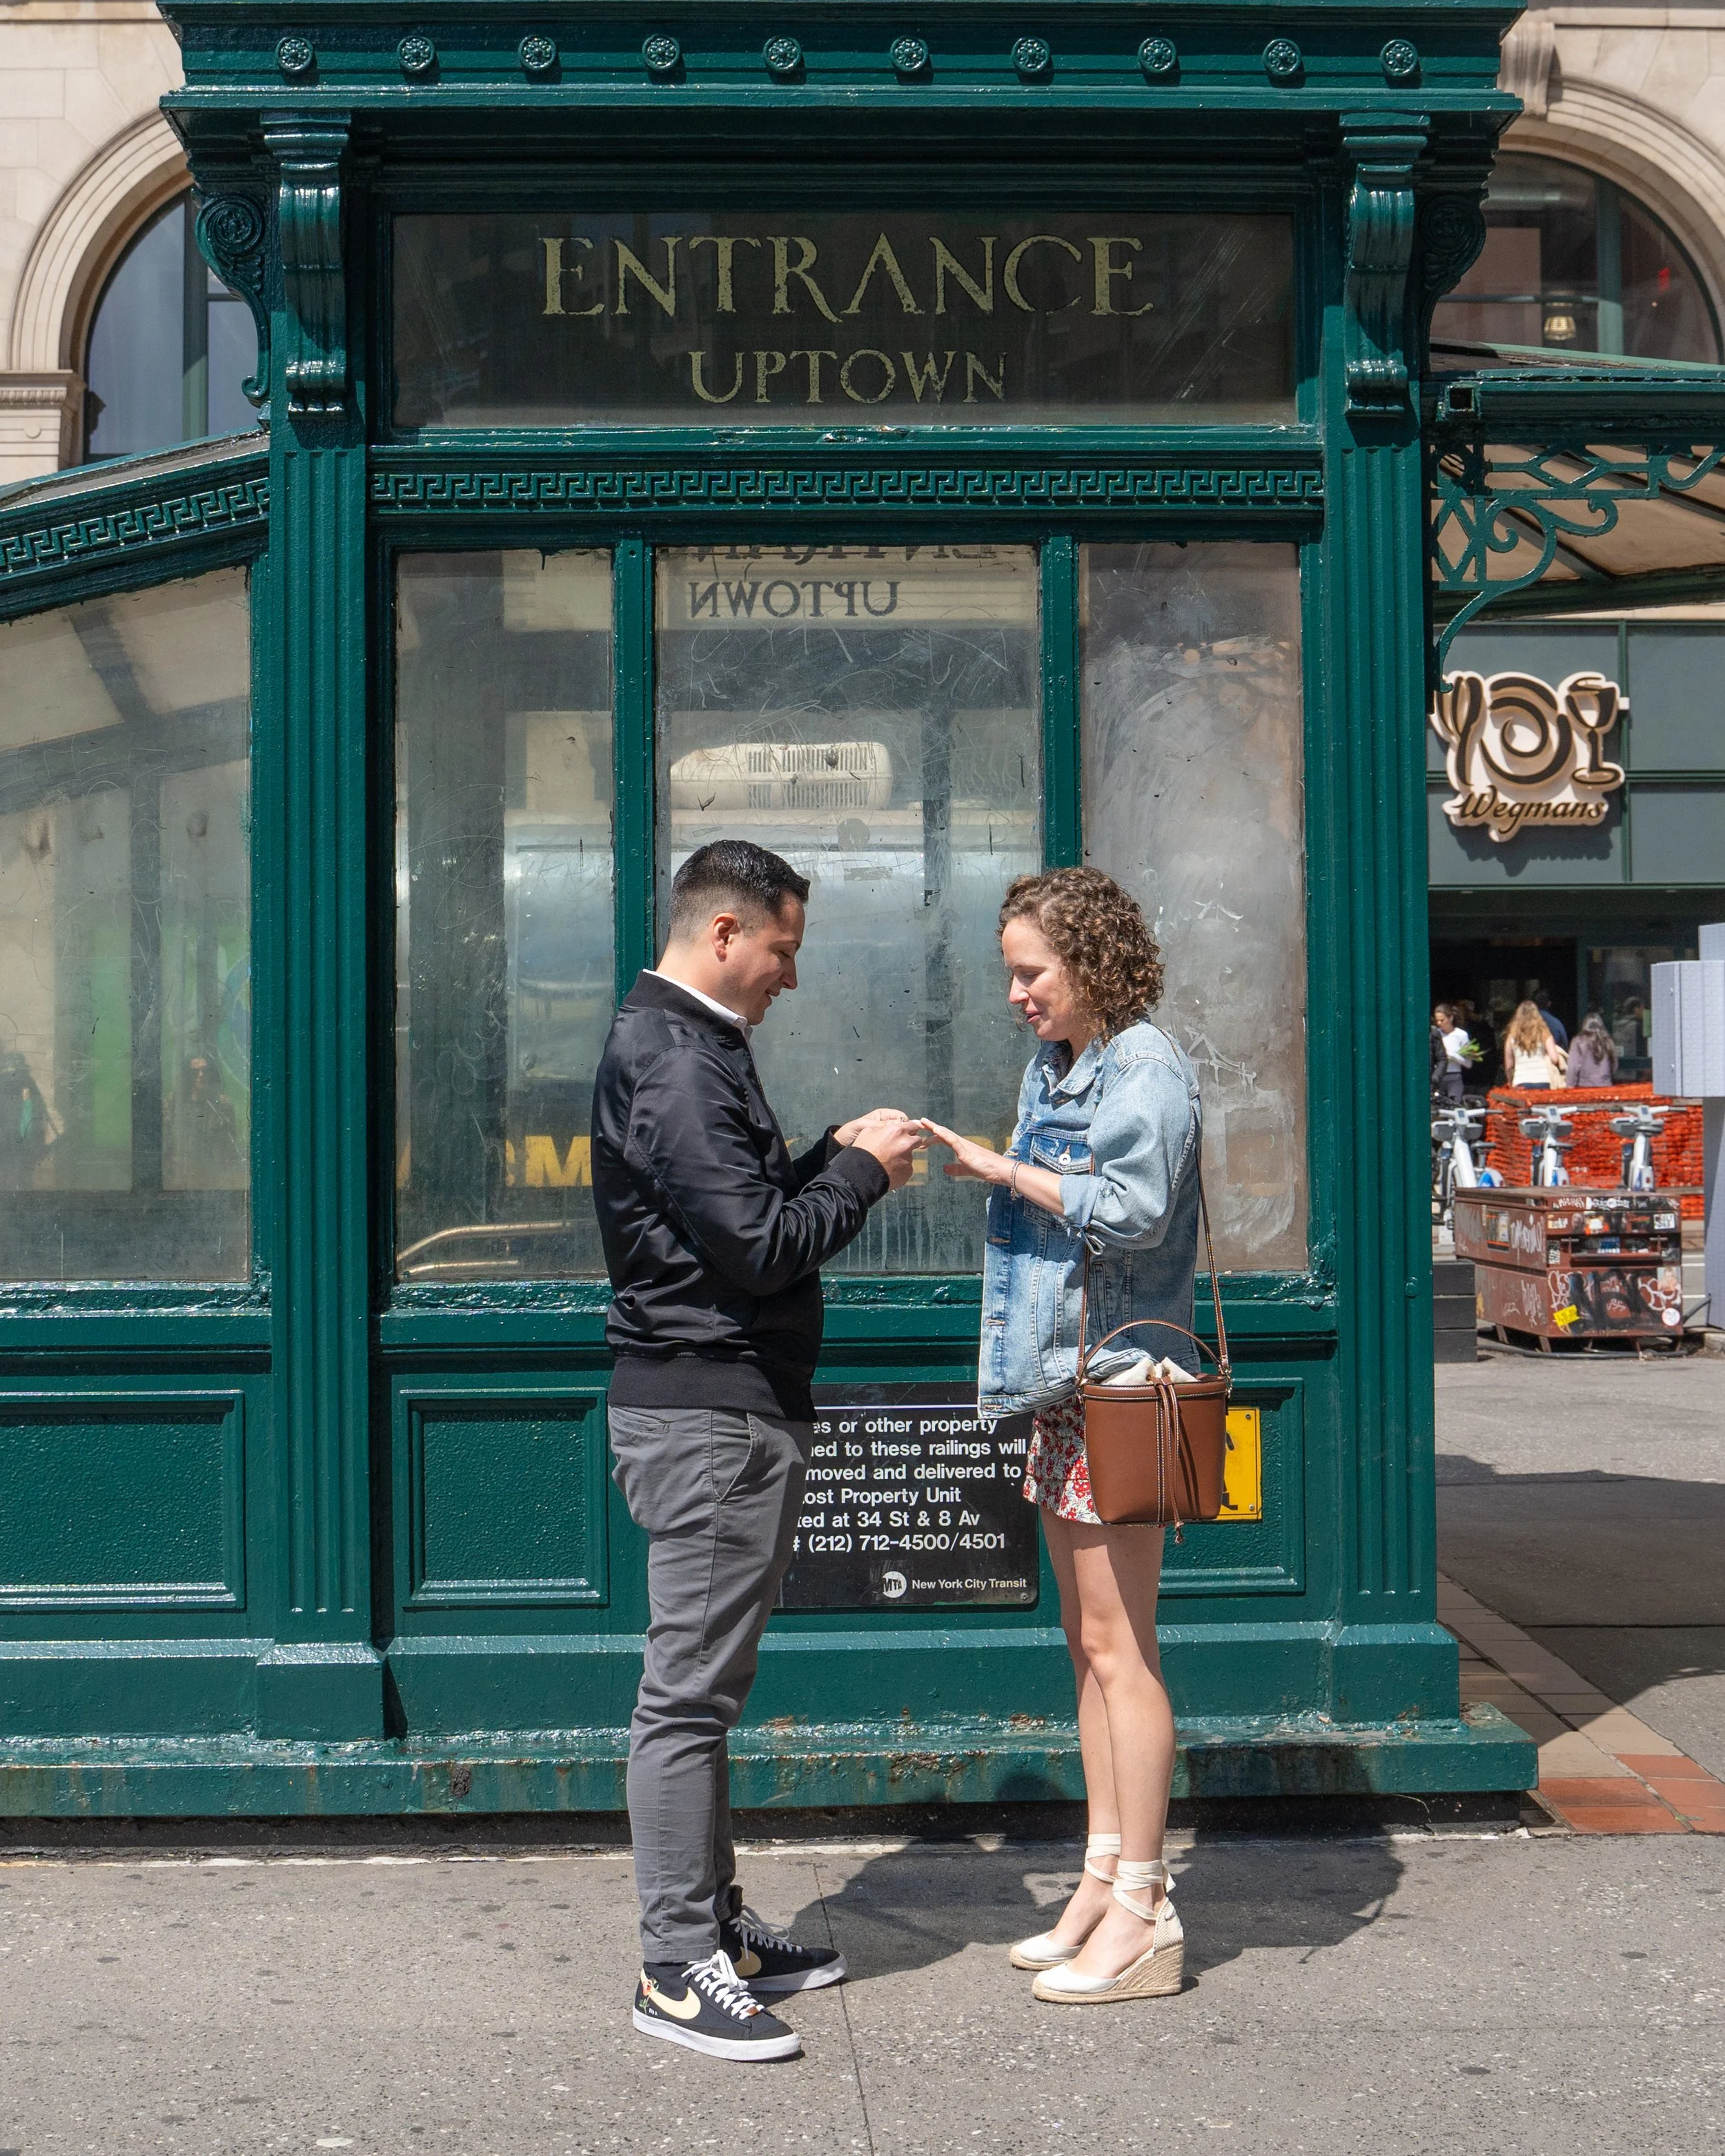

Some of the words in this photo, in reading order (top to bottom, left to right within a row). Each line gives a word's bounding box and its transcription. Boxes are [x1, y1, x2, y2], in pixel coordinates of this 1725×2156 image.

[540, 233, 1154, 322] ENTRANCE
[690, 350, 1007, 404] UPTOWN
[1452, 784, 1604, 834] Wegmans
[838, 1421, 858, 1433] or
[865, 1417, 913, 1433] other
[920, 1419, 998, 1435] property
[811, 1441, 837, 1457] ed
[845, 1442, 862, 1457] to
[871, 1441, 921, 1456] these
[929, 1439, 991, 1458] railings
[998, 1438, 1026, 1454] will
[873, 1463, 906, 1480] and
[914, 1463, 996, 1479] delivered
[1003, 1463, 1022, 1478] to
[802, 1489, 834, 1504] ost
[841, 1488, 919, 1507] Property
[926, 1487, 962, 1503] Unit
[832, 1512, 850, 1527] at
[857, 1511, 882, 1527] 34
[889, 1510, 909, 1527] St
[917, 1511, 931, 1527] &
[938, 1510, 951, 1527] 8
[958, 1511, 980, 1526] Av
[809, 1533, 852, 1553] (212)
[859, 1532, 1005, 1552] 712-4500/4501
[911, 1579, 936, 1589] New
[938, 1579, 963, 1589] York
[965, 1579, 987, 1590] City
[988, 1578, 1027, 1588] Transit
